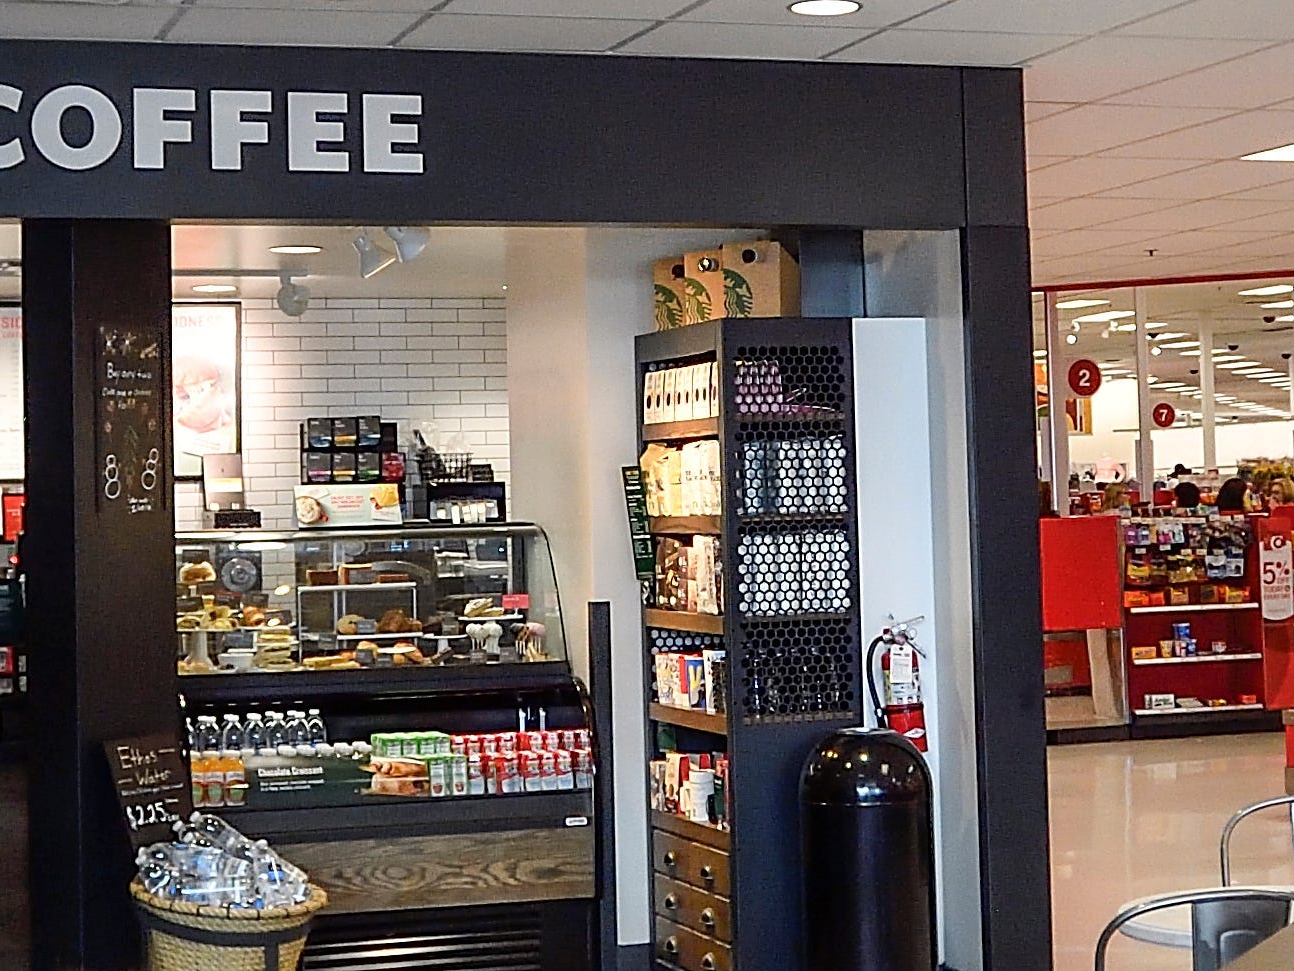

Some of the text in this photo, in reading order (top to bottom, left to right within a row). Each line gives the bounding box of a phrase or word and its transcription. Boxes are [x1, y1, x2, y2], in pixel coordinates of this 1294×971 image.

[1078, 369, 1091, 387] 2
[1159, 409, 1168, 422] 7
[1263, 560, 1290, 585] 5%
[135, 768, 172, 785] Water
[257, 766, 324, 778] Chocolate Croissant
